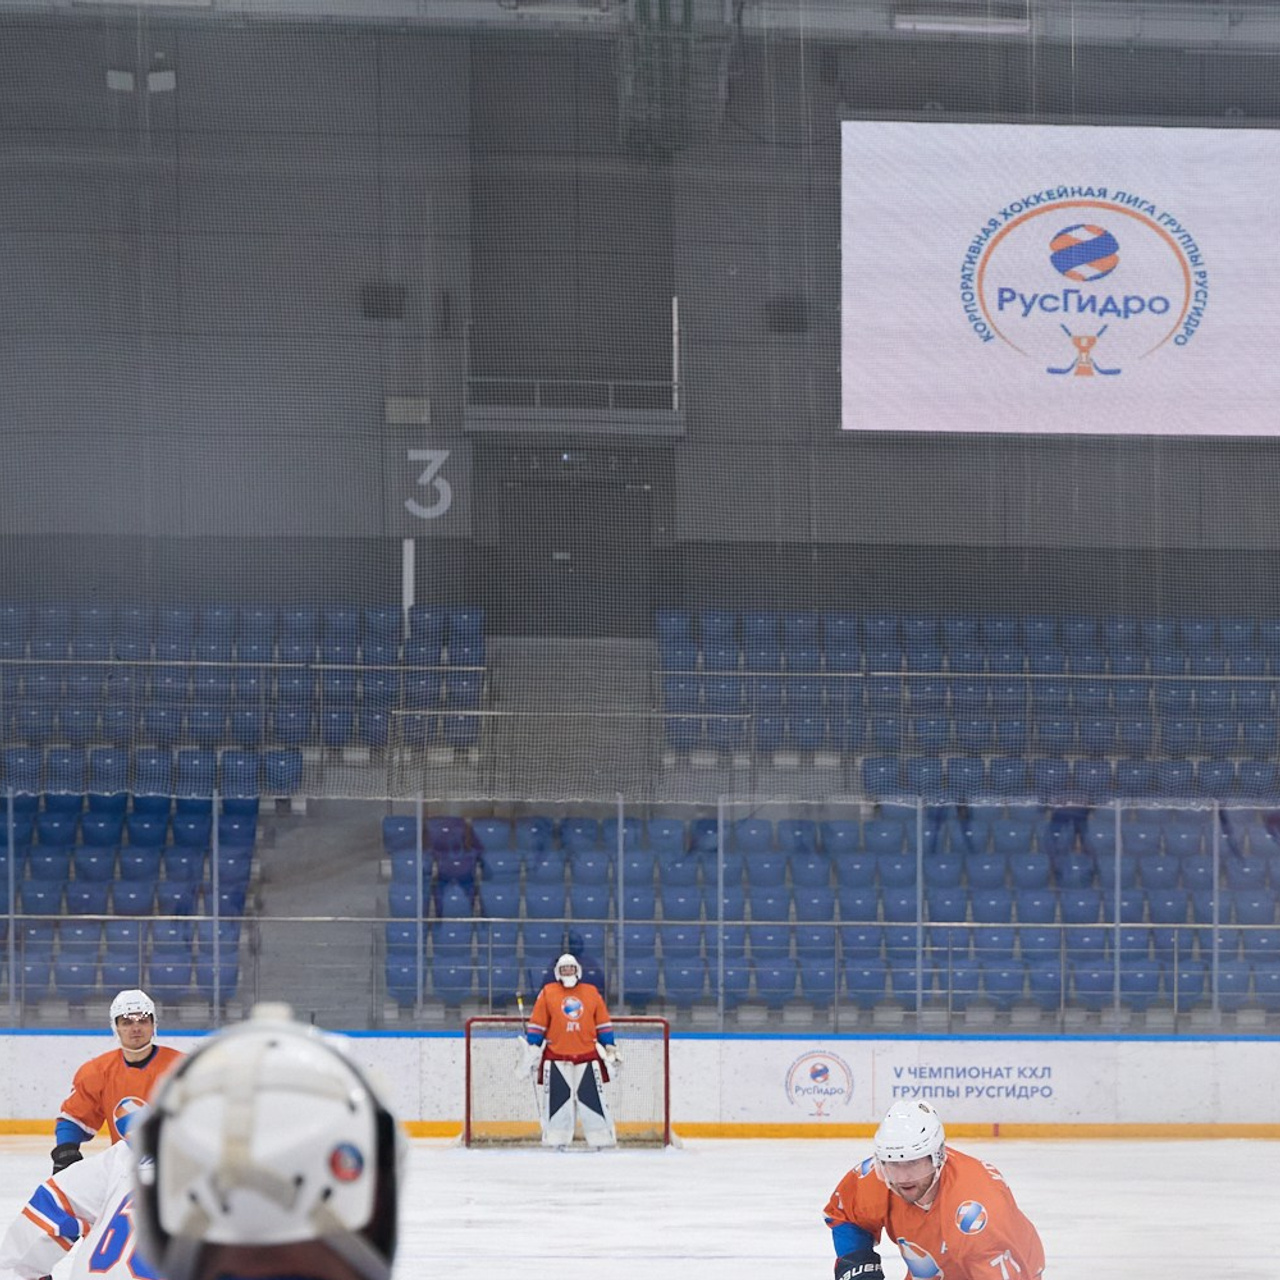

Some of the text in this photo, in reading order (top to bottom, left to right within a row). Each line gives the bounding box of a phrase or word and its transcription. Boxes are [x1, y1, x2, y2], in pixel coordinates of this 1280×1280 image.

[960, 185, 1209, 347] КОРПОРАТИВНАЯ ХОККЕЙНАЯ ЛИГА ГРУППЫ РУСГИДРО
[998, 287, 1170, 319] РусГидро
[405, 449, 452, 519] 3
[893, 1066, 1052, 1079] V ЧЕМПИОНАТ КХЛ
[794, 1085, 844, 1096] РусГидро
[892, 1085, 1053, 1099] ГРУППЫ РУСГИДРО
